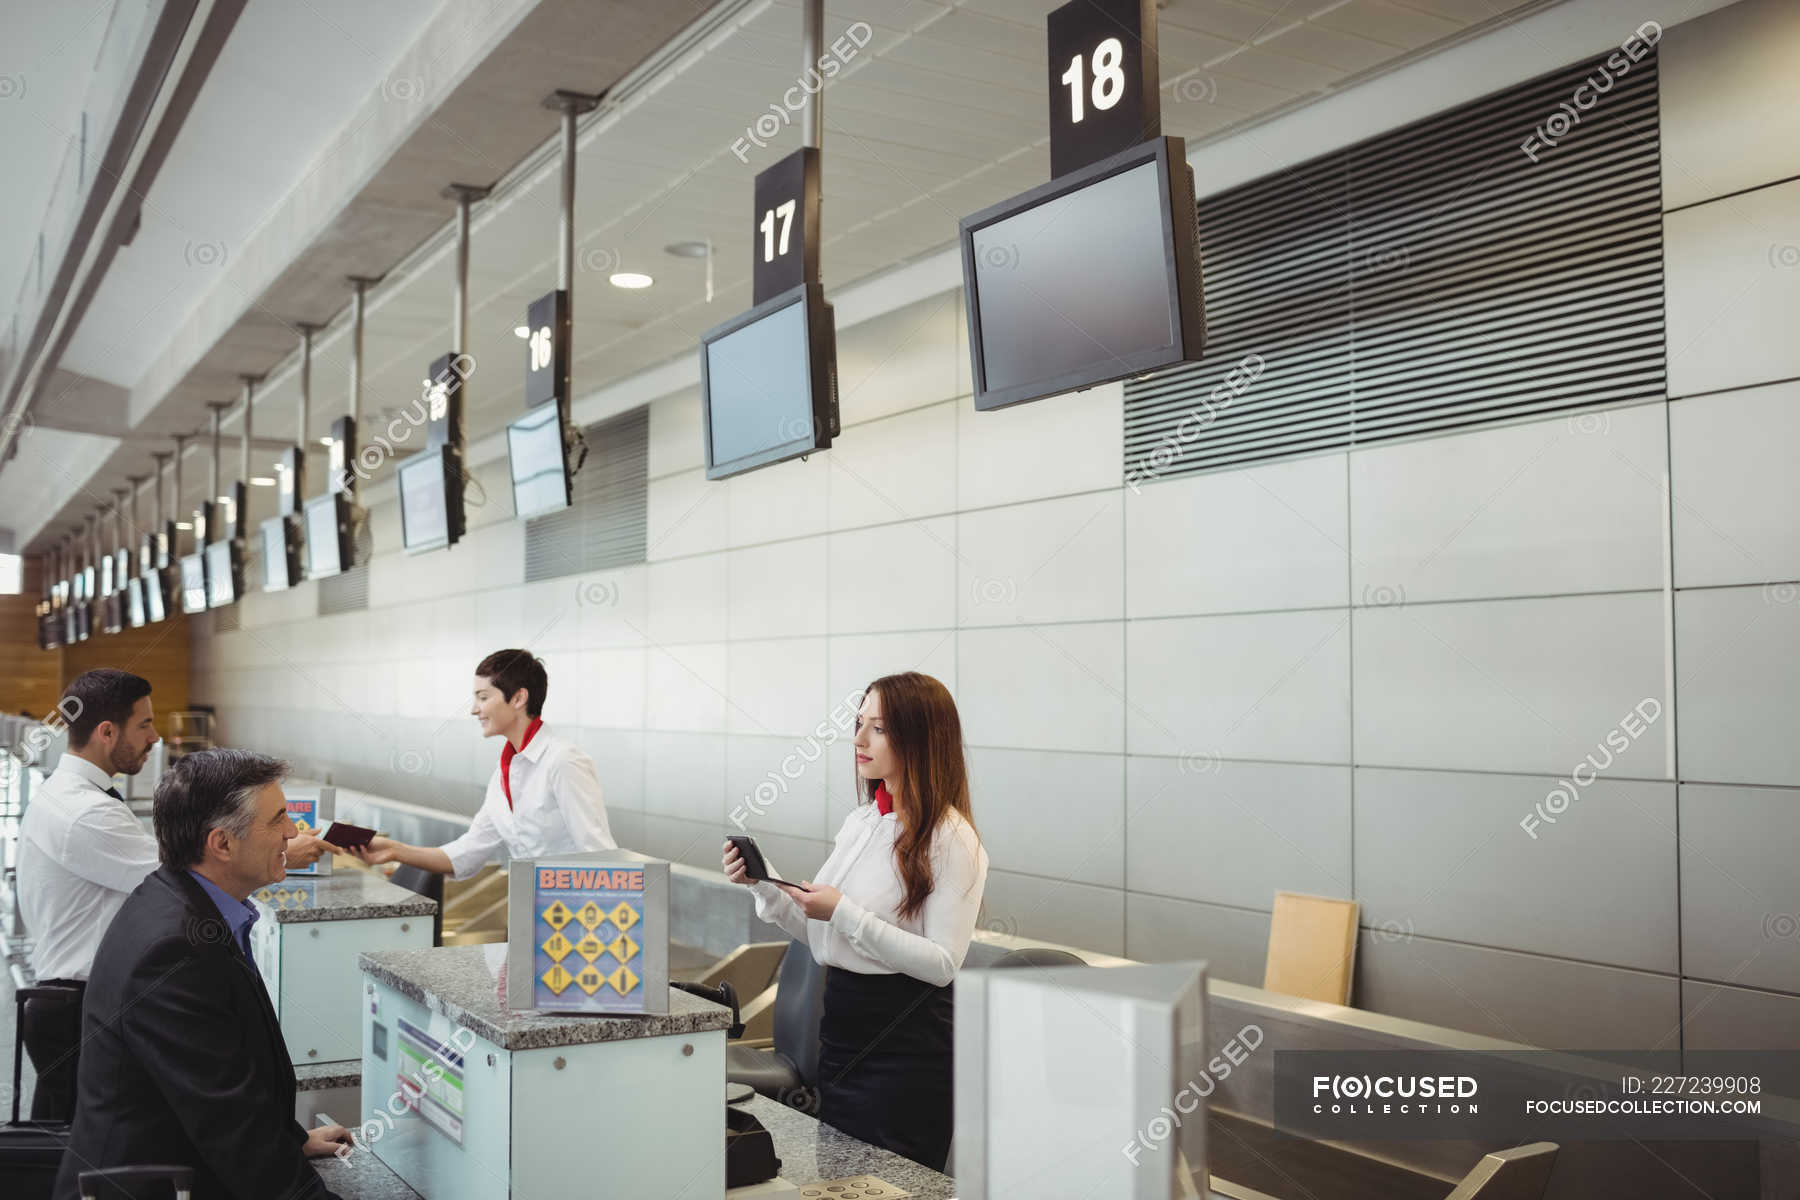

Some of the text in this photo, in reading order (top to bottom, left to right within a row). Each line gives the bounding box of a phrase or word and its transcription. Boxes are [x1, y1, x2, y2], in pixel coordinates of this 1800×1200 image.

[1062, 37, 1125, 124] 18
[760, 199, 796, 263] 17
[529, 326, 551, 372] 16
[539, 869, 645, 891] BEWARE
